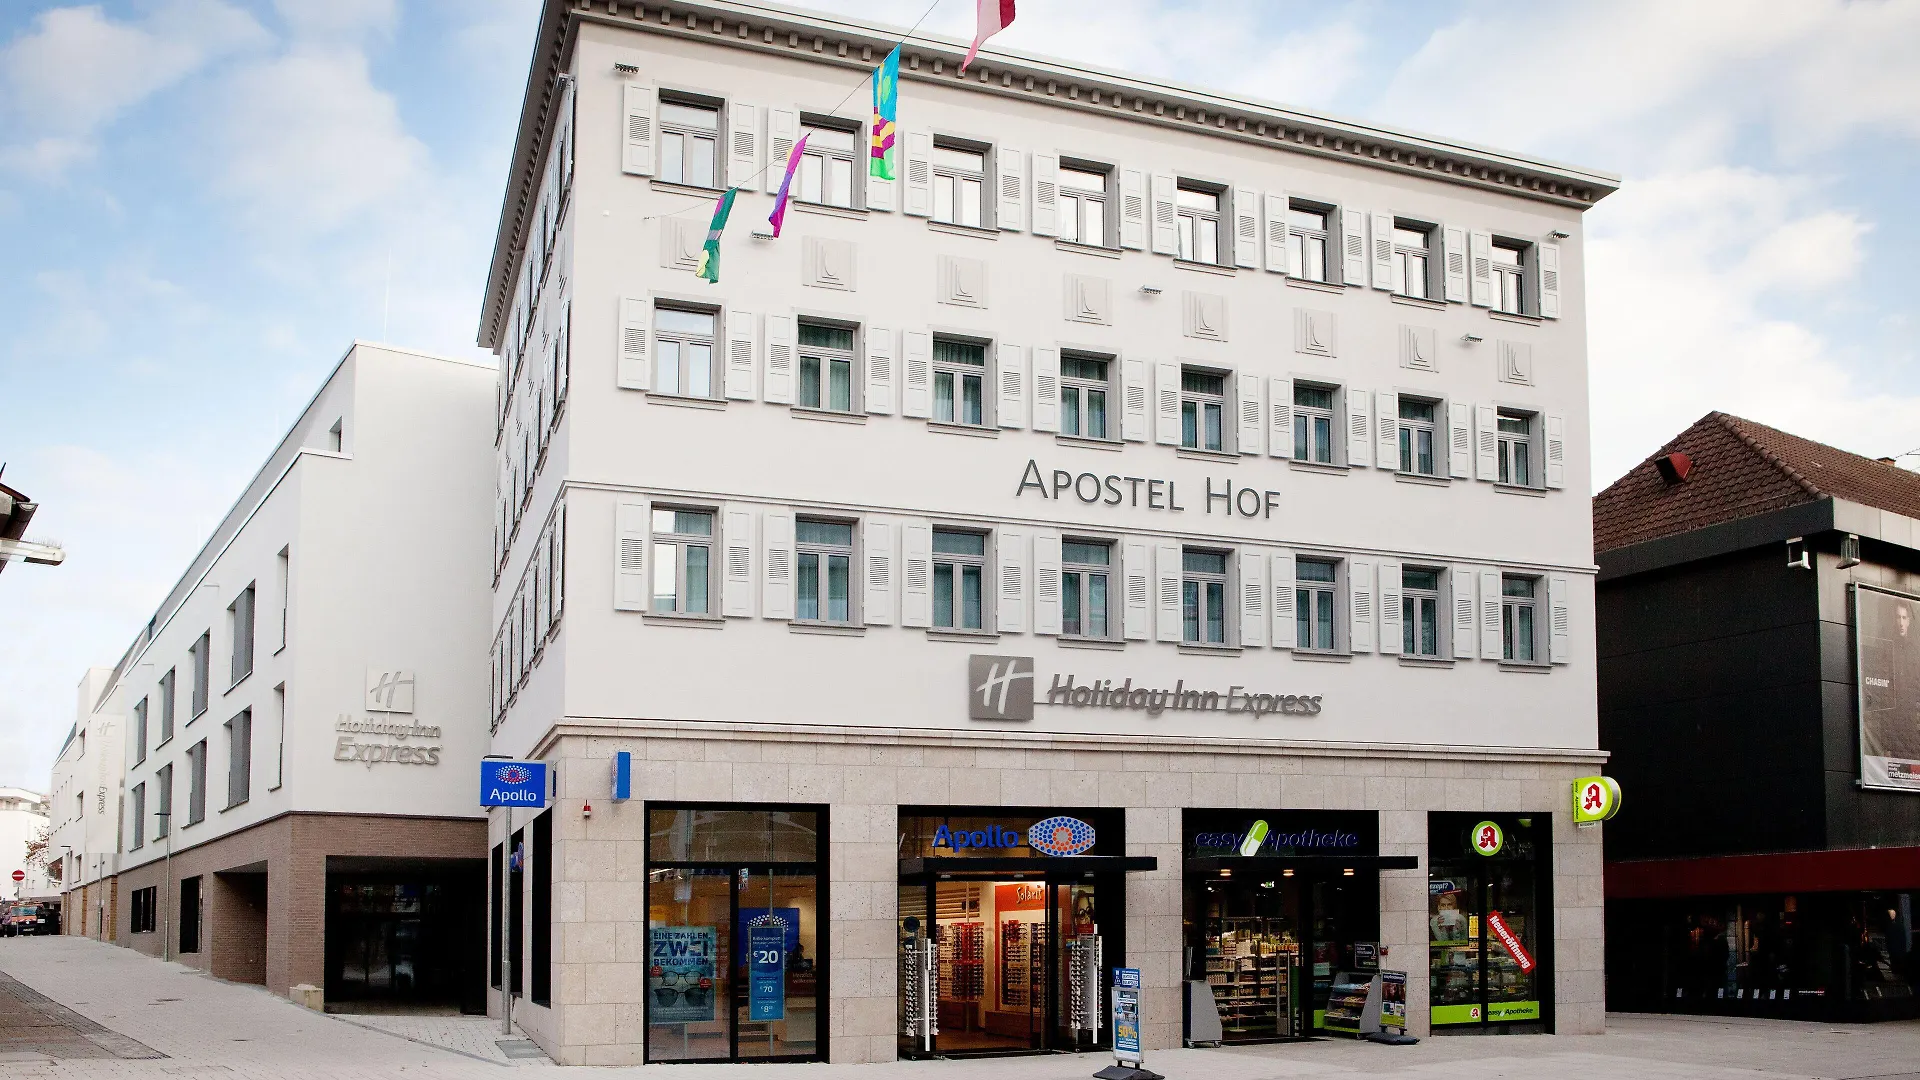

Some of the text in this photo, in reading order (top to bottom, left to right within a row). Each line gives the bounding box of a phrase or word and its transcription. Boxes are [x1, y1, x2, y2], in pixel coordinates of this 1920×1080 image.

[1016, 459, 1280, 519] APOSTEL HOF
[1047, 673, 1322, 718] Holiday Inn Express
[335, 713, 442, 740] Holiday Inn
[333, 736, 442, 769] Express
[96, 785, 108, 815] Express
[489, 788, 537, 804] Apollo
[1583, 783, 1603, 811] A
[932, 824, 1019, 853] Apollo
[1195, 829, 1360, 852] easy Apotheke
[1479, 825, 1498, 849] A
[1016, 884, 1042, 904] Solaris
[653, 932, 673, 940] EINE
[653, 940, 709, 957] ZWEI
[1489, 914, 1532, 970] Neueröffnung
[1505, 1007, 1534, 1015] Apotheke
